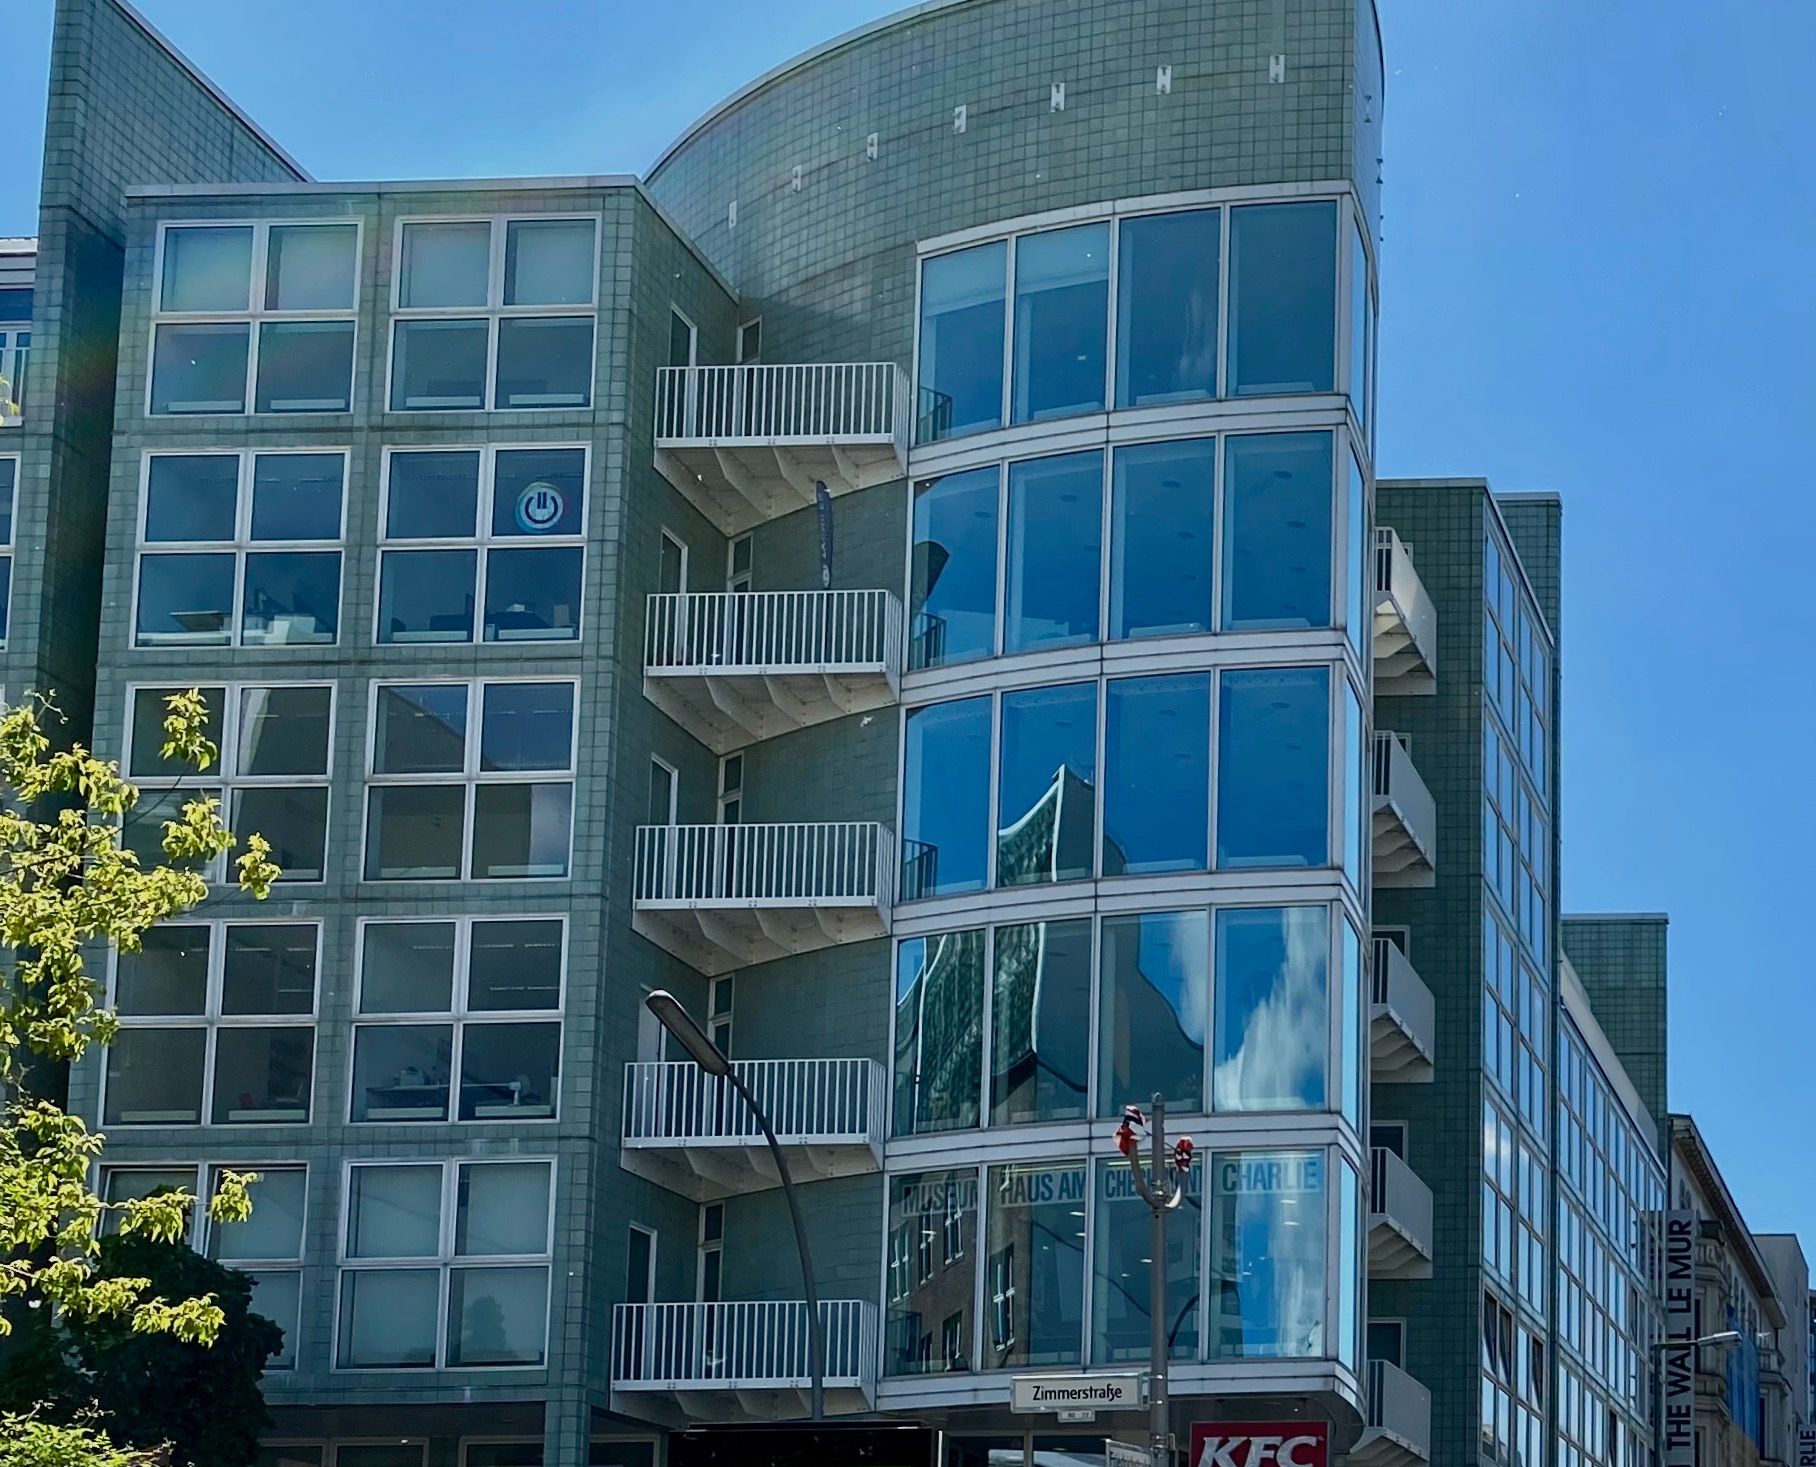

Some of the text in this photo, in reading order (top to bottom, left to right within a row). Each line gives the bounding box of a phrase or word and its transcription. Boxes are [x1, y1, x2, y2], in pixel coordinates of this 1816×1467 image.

[1003, 1173, 1053, 1205] HAUS
[1058, 1170, 1086, 1200] AM
[1222, 1161, 1318, 1191] CHARLIE
[1668, 1219, 1691, 1280] MUR
[1668, 1288, 1691, 1314] LE
[1667, 1327, 1691, 1400] WALL
[1032, 1383, 1122, 1401] Zimmerstraße
[1667, 1405, 1691, 1451] THE
